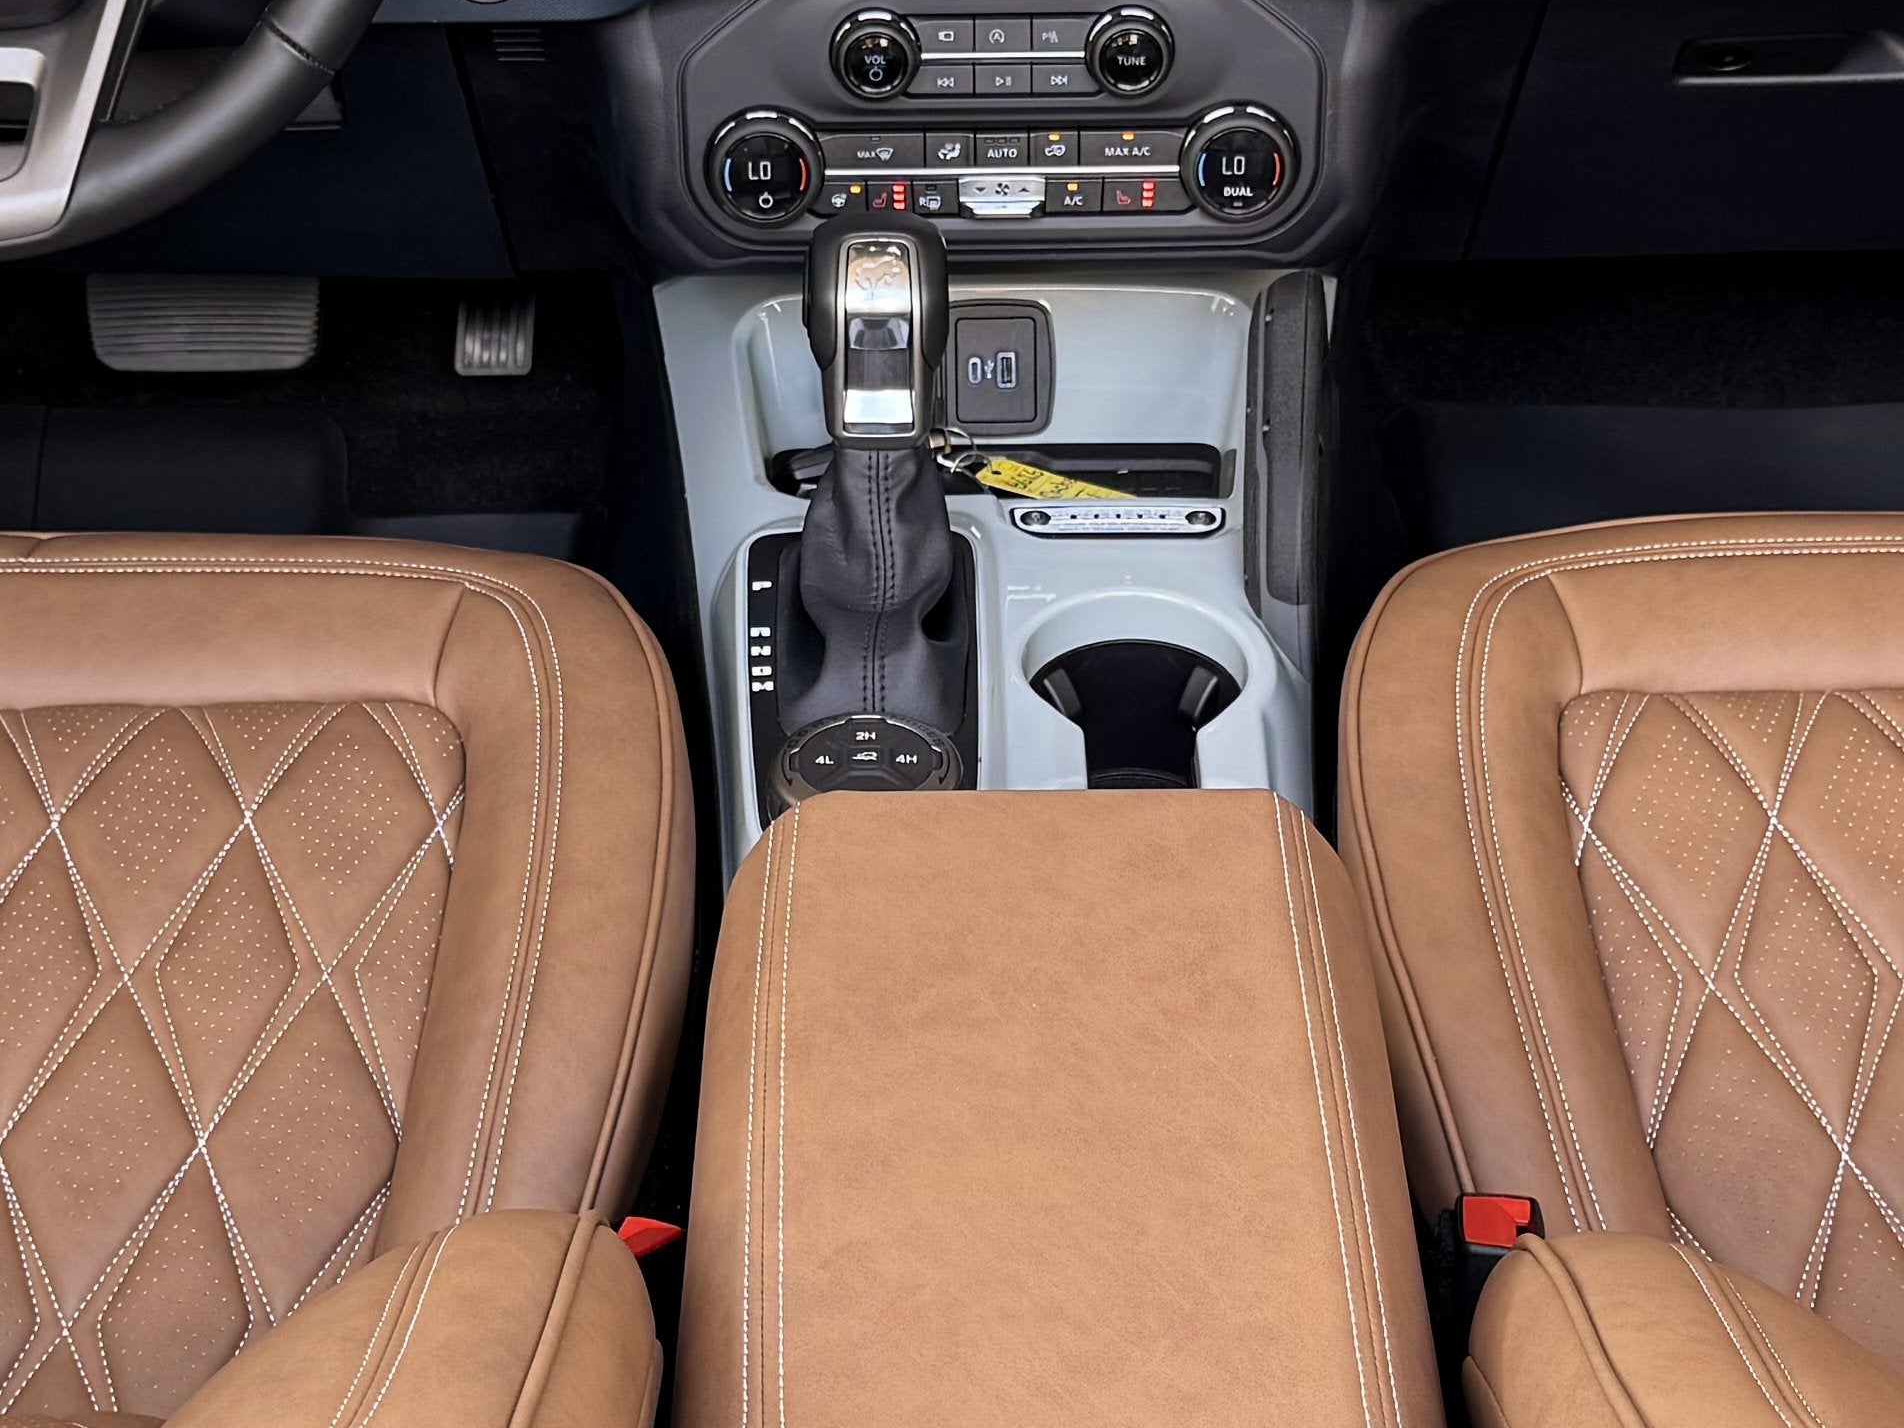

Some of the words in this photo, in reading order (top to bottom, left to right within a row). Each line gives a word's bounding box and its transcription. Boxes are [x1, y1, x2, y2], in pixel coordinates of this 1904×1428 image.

[864, 55, 886, 66] VOL
[1117, 56, 1146, 67] TUNE
[987, 147, 1017, 159] AUTO
[1104, 147, 1129, 158] MAX
[1130, 146, 1151, 158] A/C
[748, 161, 772, 181] LO
[1222, 156, 1246, 175] LO
[1224, 186, 1253, 197] DUAL
[1064, 195, 1084, 208] A/C
[855, 732, 876, 741] 2H
[815, 756, 834, 765] 4L
[896, 755, 918, 764] 4H
